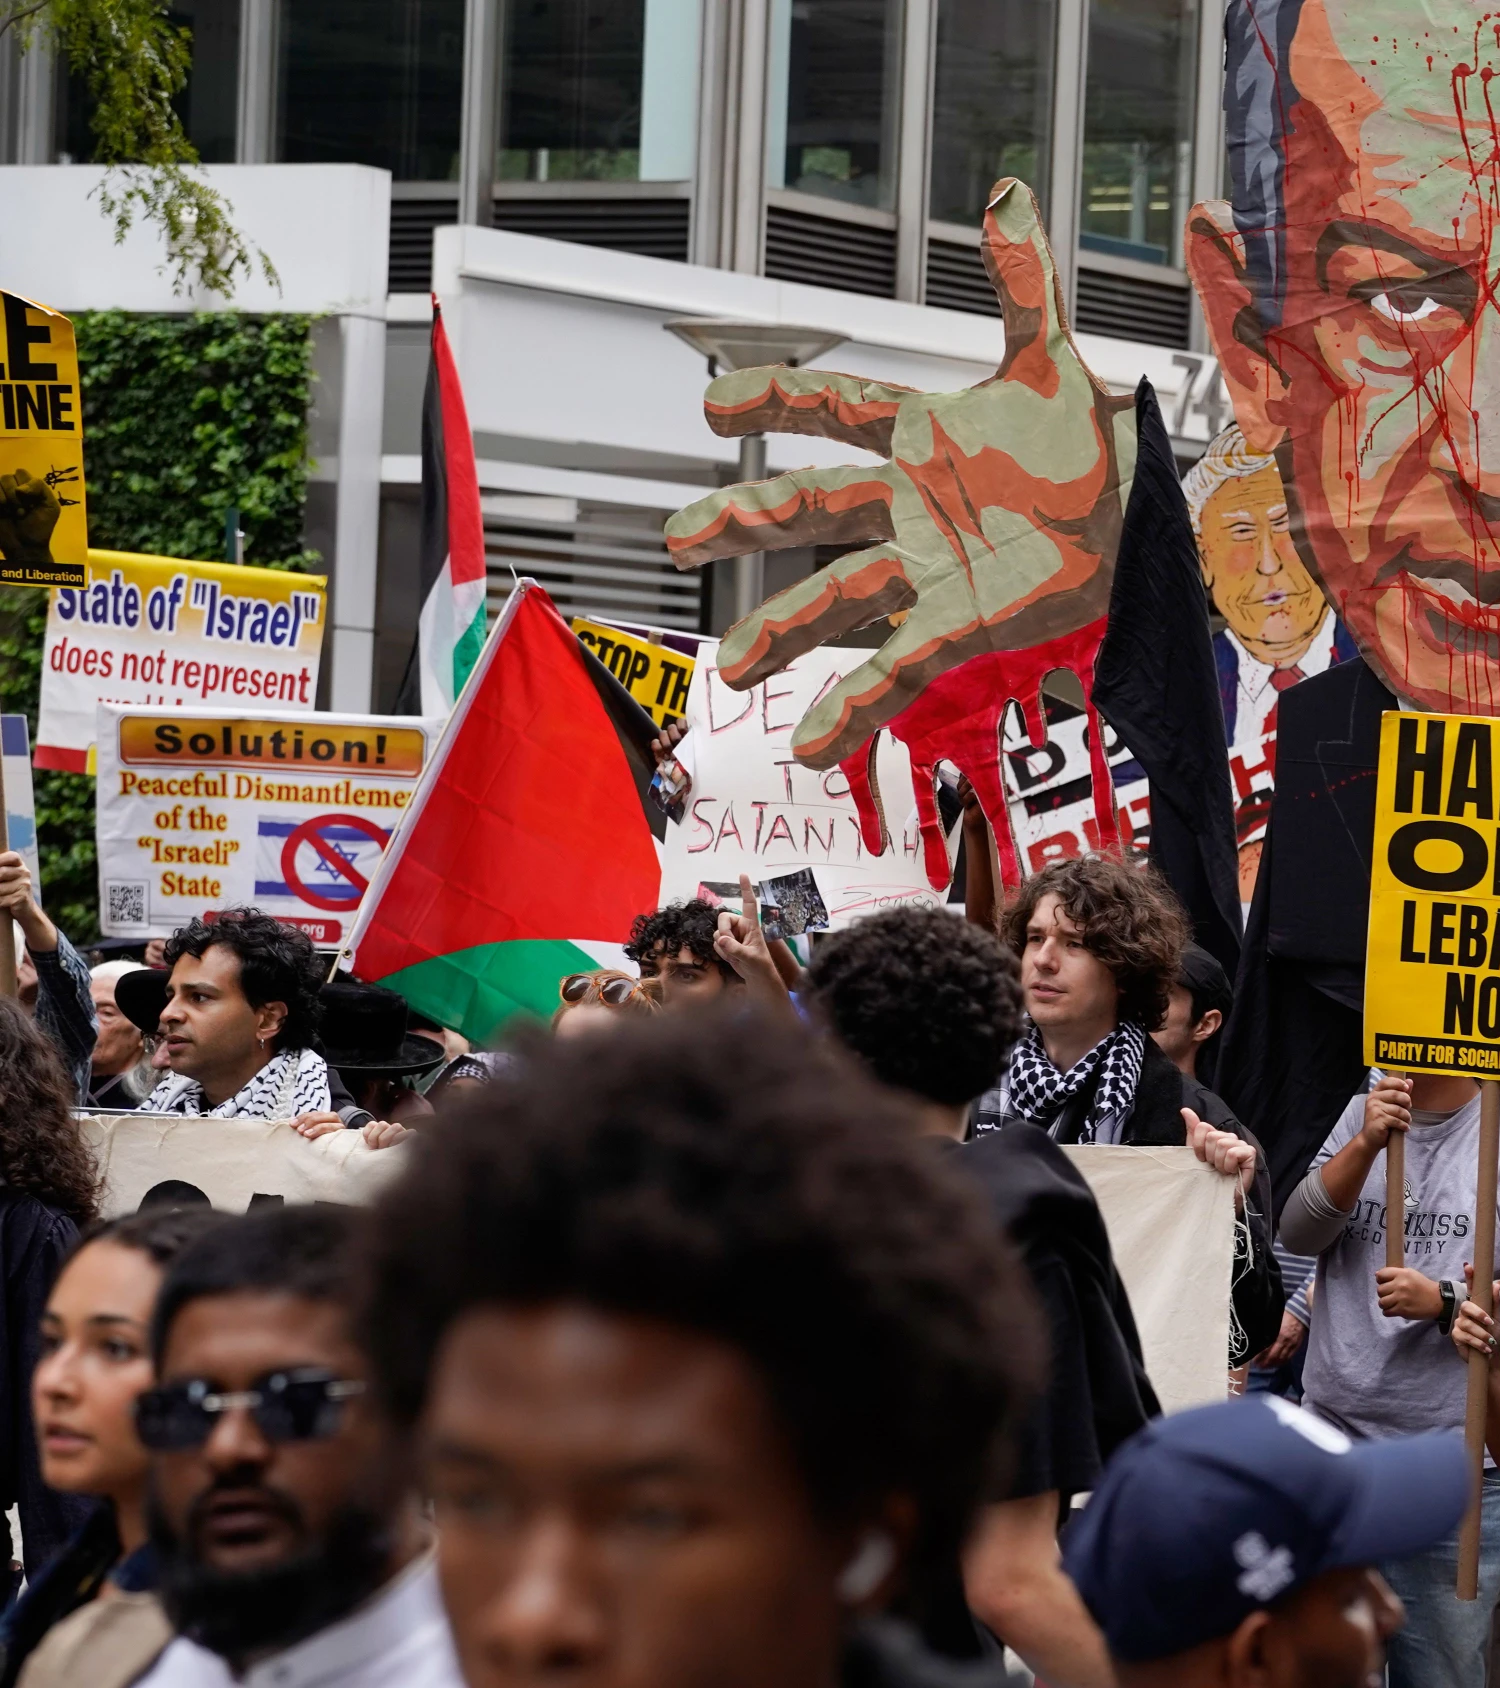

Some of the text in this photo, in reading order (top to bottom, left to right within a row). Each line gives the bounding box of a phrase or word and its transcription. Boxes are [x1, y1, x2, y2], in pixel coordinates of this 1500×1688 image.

[0, 290, 58, 381] E
[0, 384, 75, 431] INE
[1, 568, 83, 583] and Liberation
[57, 574, 317, 647] State of "Israel"
[51, 637, 310, 703] does not represent
[656, 660, 694, 714] TH
[154, 724, 387, 764] Solution!
[119, 771, 414, 808] Peaceful Dismantleme
[155, 807, 228, 832] of the
[160, 871, 221, 898] State
[1379, 1040, 1424, 1062] PARTY
[1427, 1044, 1455, 1065] FOR
